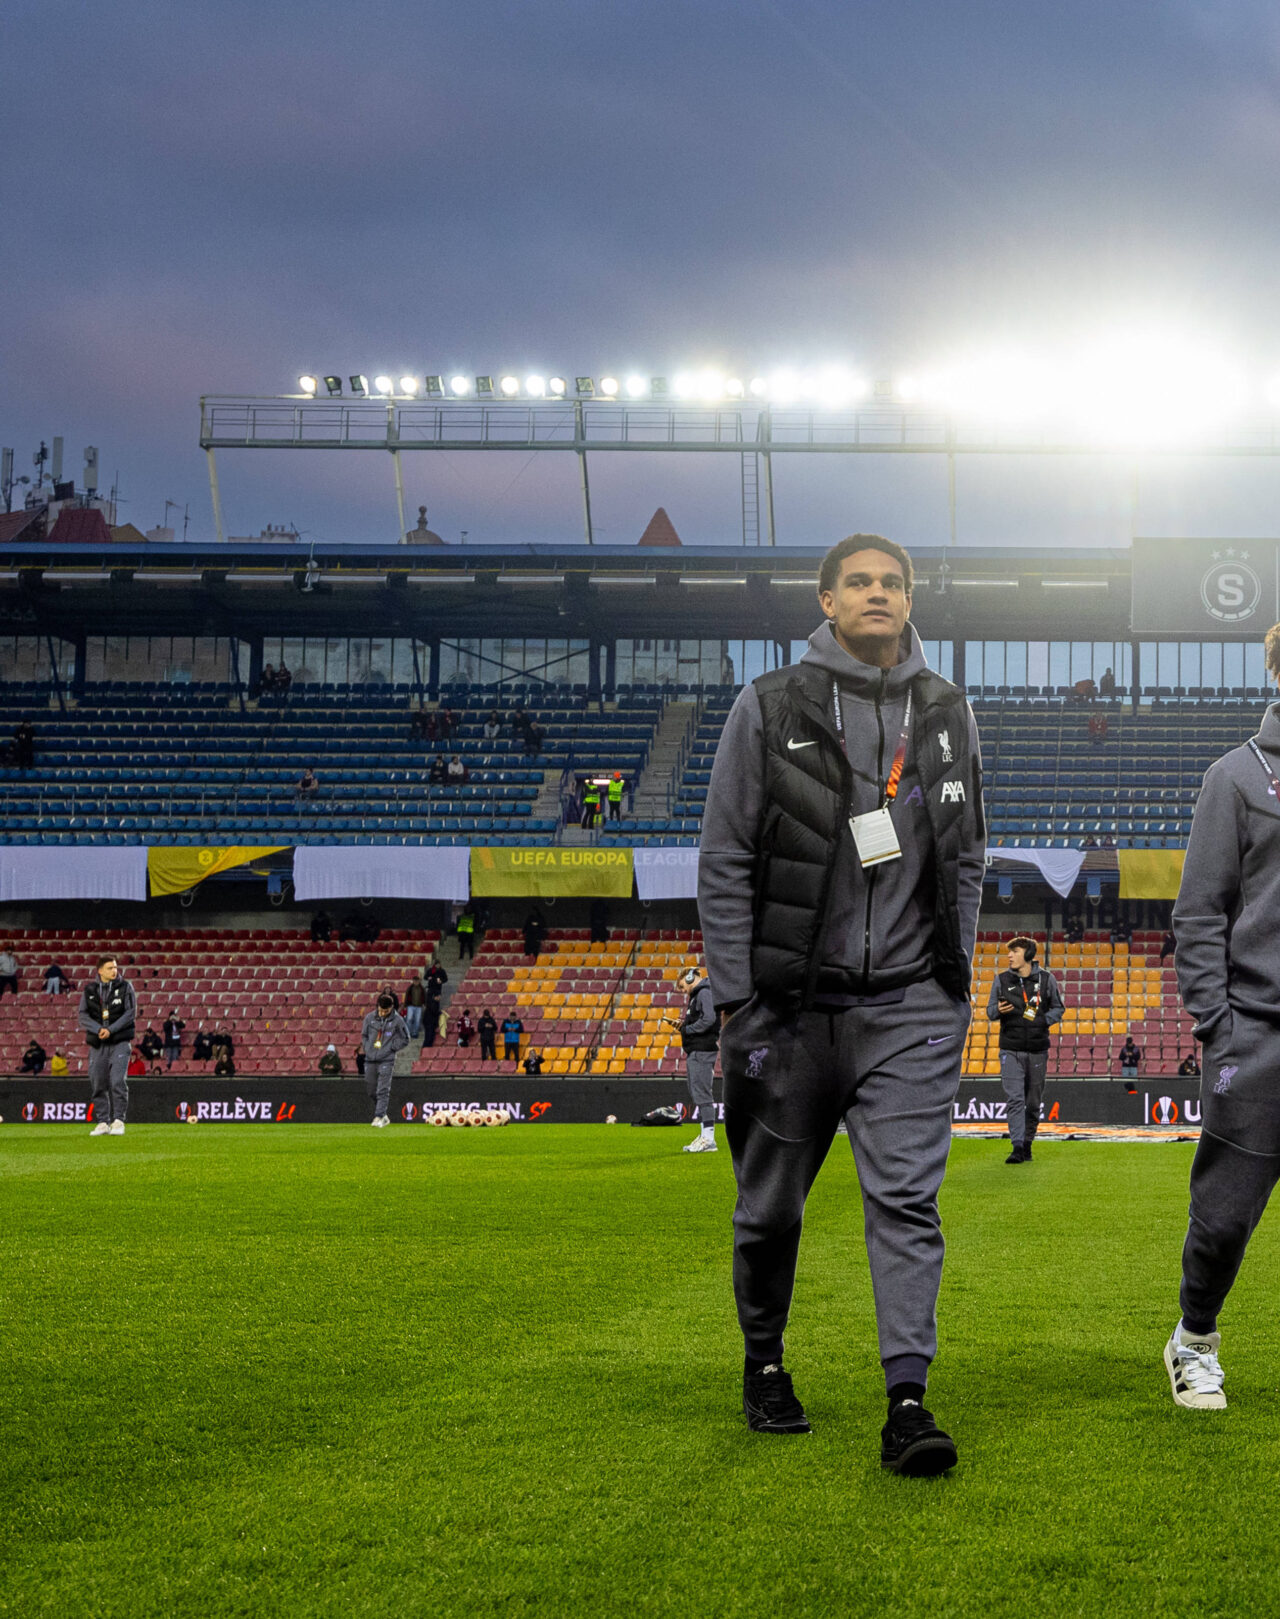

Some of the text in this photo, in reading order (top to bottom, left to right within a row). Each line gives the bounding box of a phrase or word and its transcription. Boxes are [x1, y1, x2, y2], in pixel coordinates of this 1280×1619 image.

[1217, 573, 1244, 606] S
[940, 781, 966, 803] AXA
[511, 852, 557, 866] UEFA
[560, 852, 628, 866] EUROPA
[43, 1103, 87, 1120] RISE
[197, 1097, 272, 1120] RELÈVE
